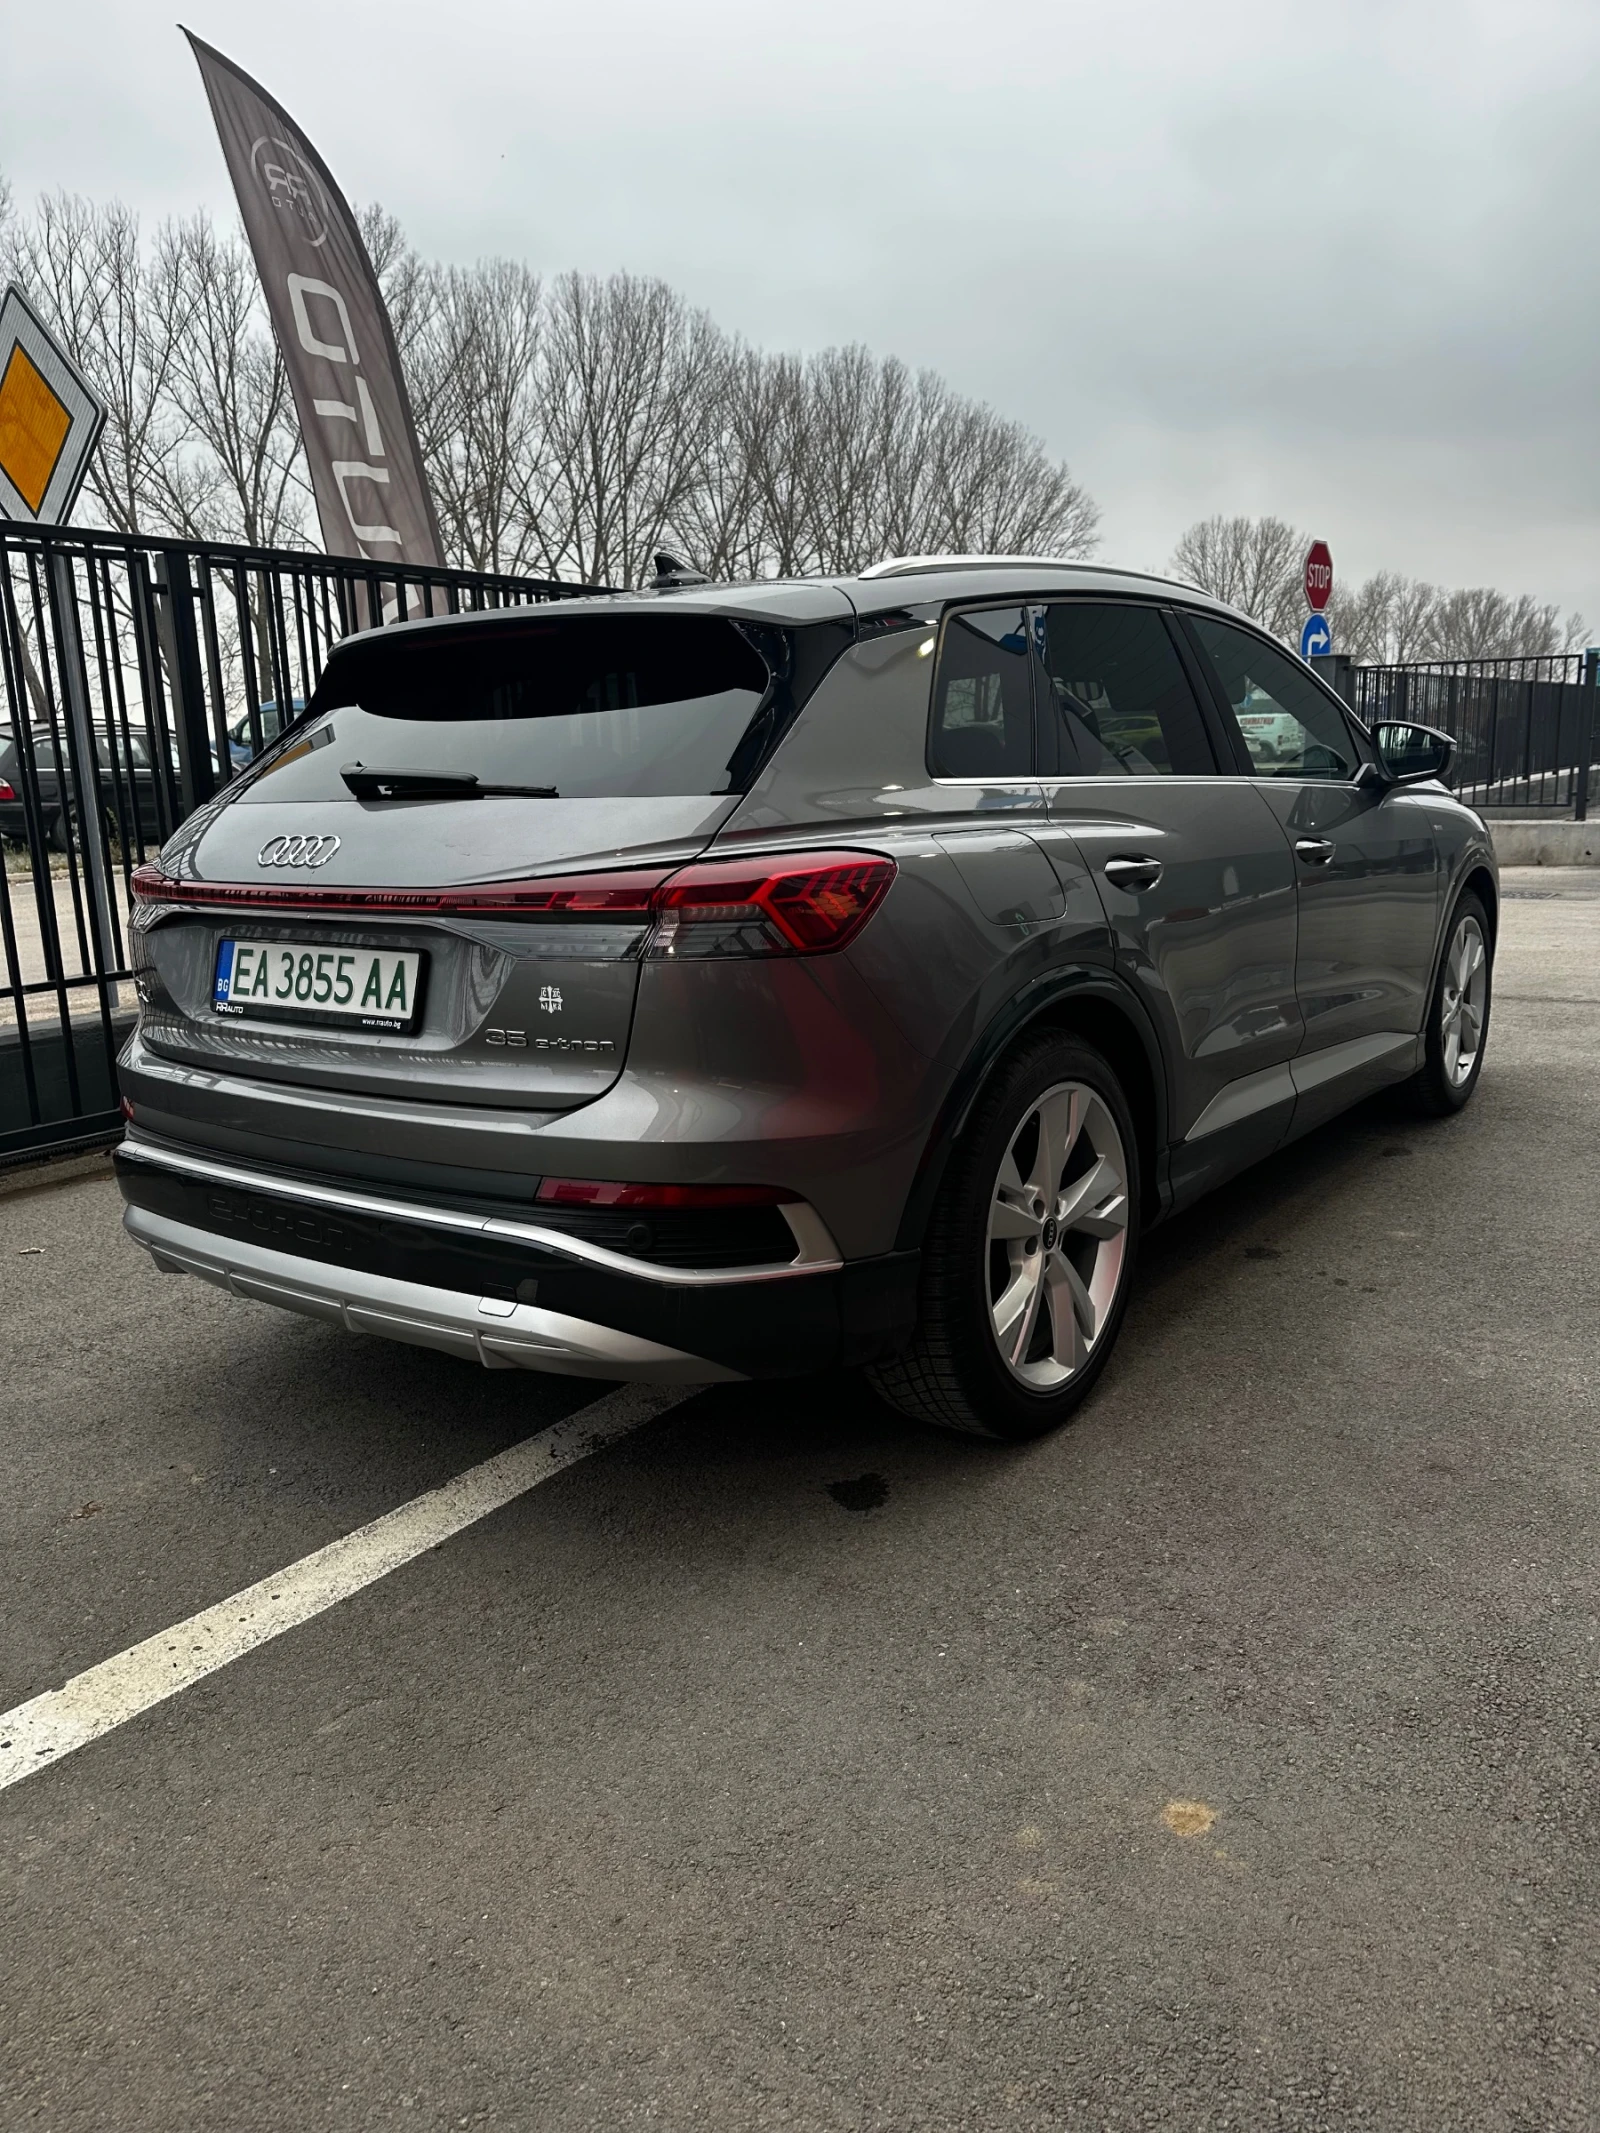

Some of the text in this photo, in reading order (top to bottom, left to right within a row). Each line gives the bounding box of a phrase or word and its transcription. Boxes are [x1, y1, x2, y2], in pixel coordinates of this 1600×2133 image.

[1308, 563, 1330, 589] STOP
[217, 978, 229, 992] BG
[485, 1028, 616, 1051] 35 e-tron
